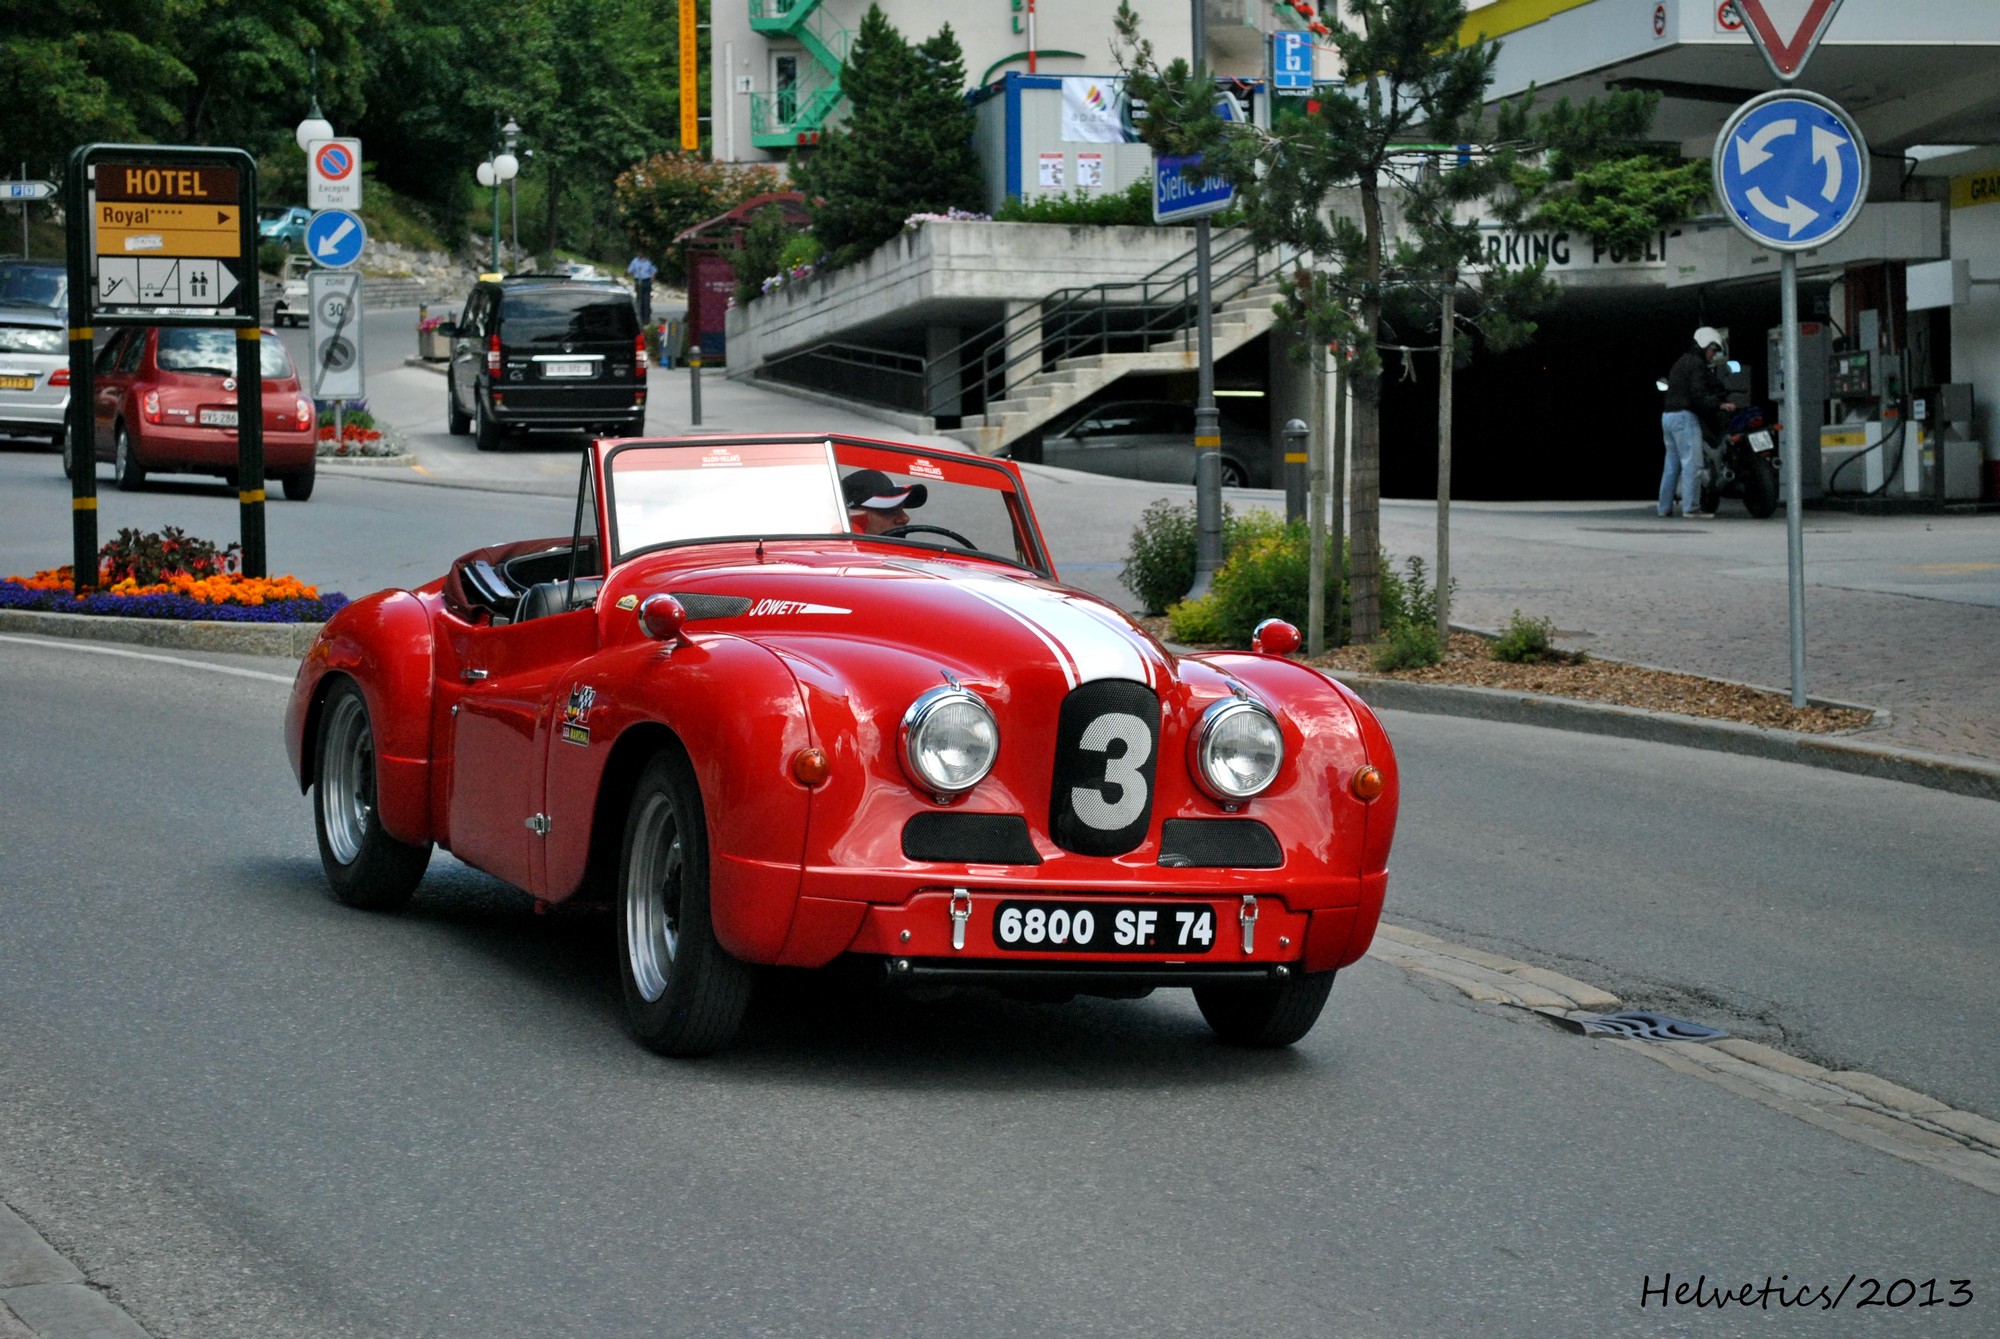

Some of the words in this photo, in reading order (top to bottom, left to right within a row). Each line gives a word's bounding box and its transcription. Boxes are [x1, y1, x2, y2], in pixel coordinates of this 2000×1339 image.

[126, 169, 208, 196] HOTEL
[103, 206, 149, 227] Royal
[1467, 233, 1570, 265] RKING
[1593, 229, 1682, 264] PUBLI
[325, 278, 346, 287] ZONE
[328, 303, 345, 317] 30
[749, 598, 807, 617] JOWETT
[1071, 712, 1152, 831] 3
[1000, 908, 1094, 944] 6800
[1114, 910, 1157, 946] SF
[1175, 911, 1213, 946] 74
